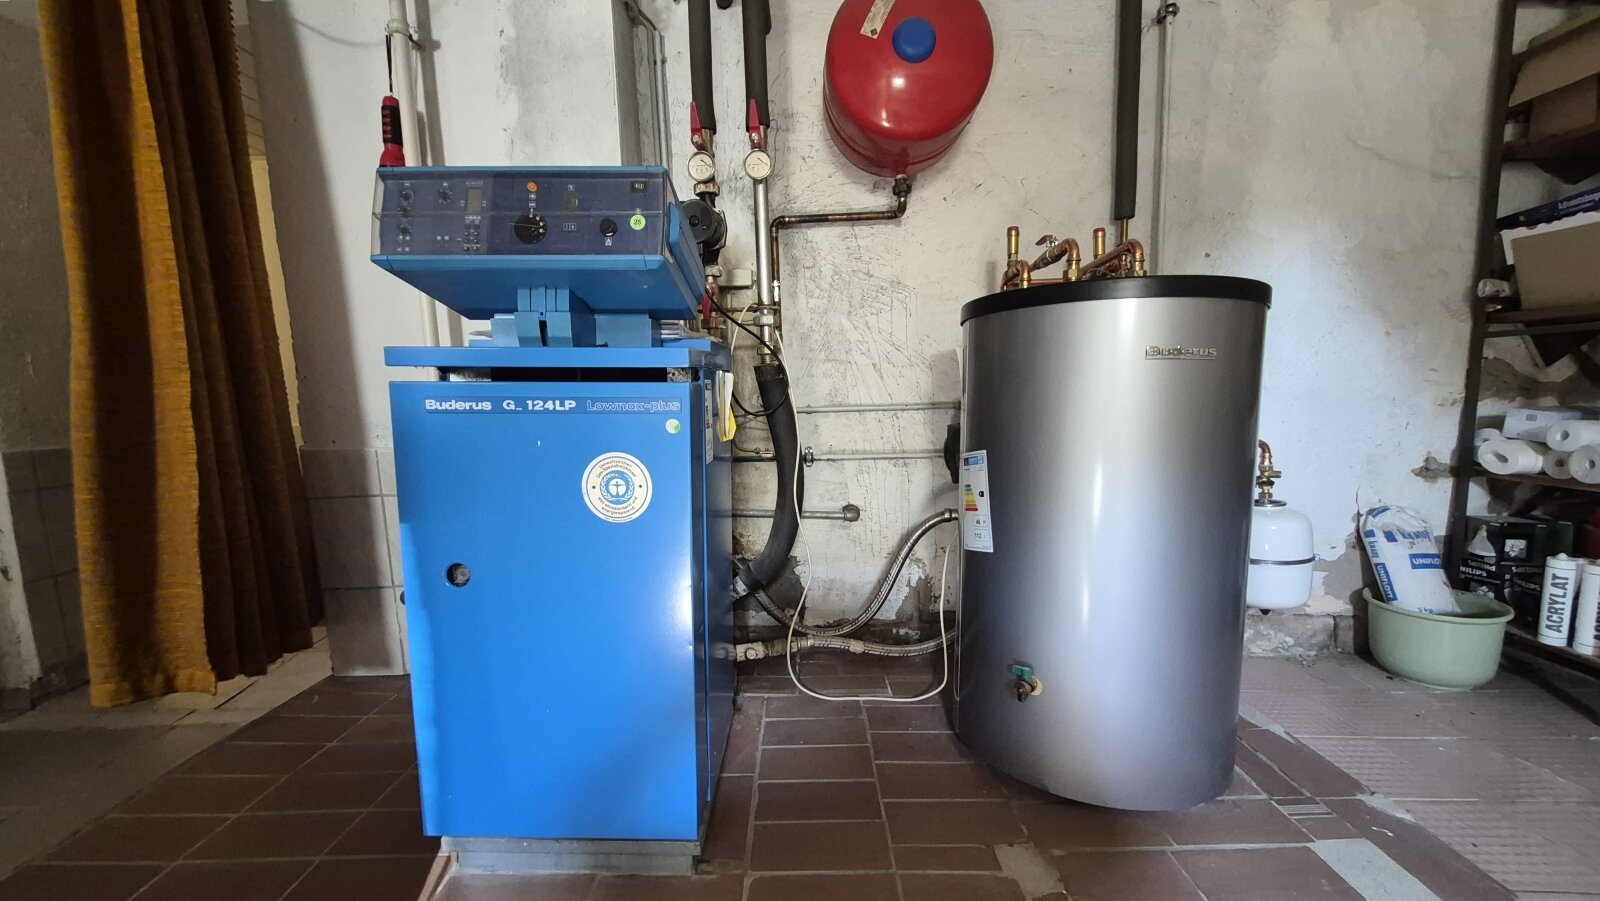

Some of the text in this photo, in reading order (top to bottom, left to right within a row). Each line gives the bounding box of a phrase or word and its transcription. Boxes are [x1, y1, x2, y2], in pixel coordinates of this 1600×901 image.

[1146, 345, 1217, 358] Buderus
[425, 399, 492, 411] Buderus
[527, 399, 577, 411] 124LP
[586, 399, 681, 412] Lownox-plus
[1459, 566, 1487, 577] HILIPS
[1376, 565, 1393, 599] UNIFLOTT
[1545, 573, 1569, 634] ACRYLAT
